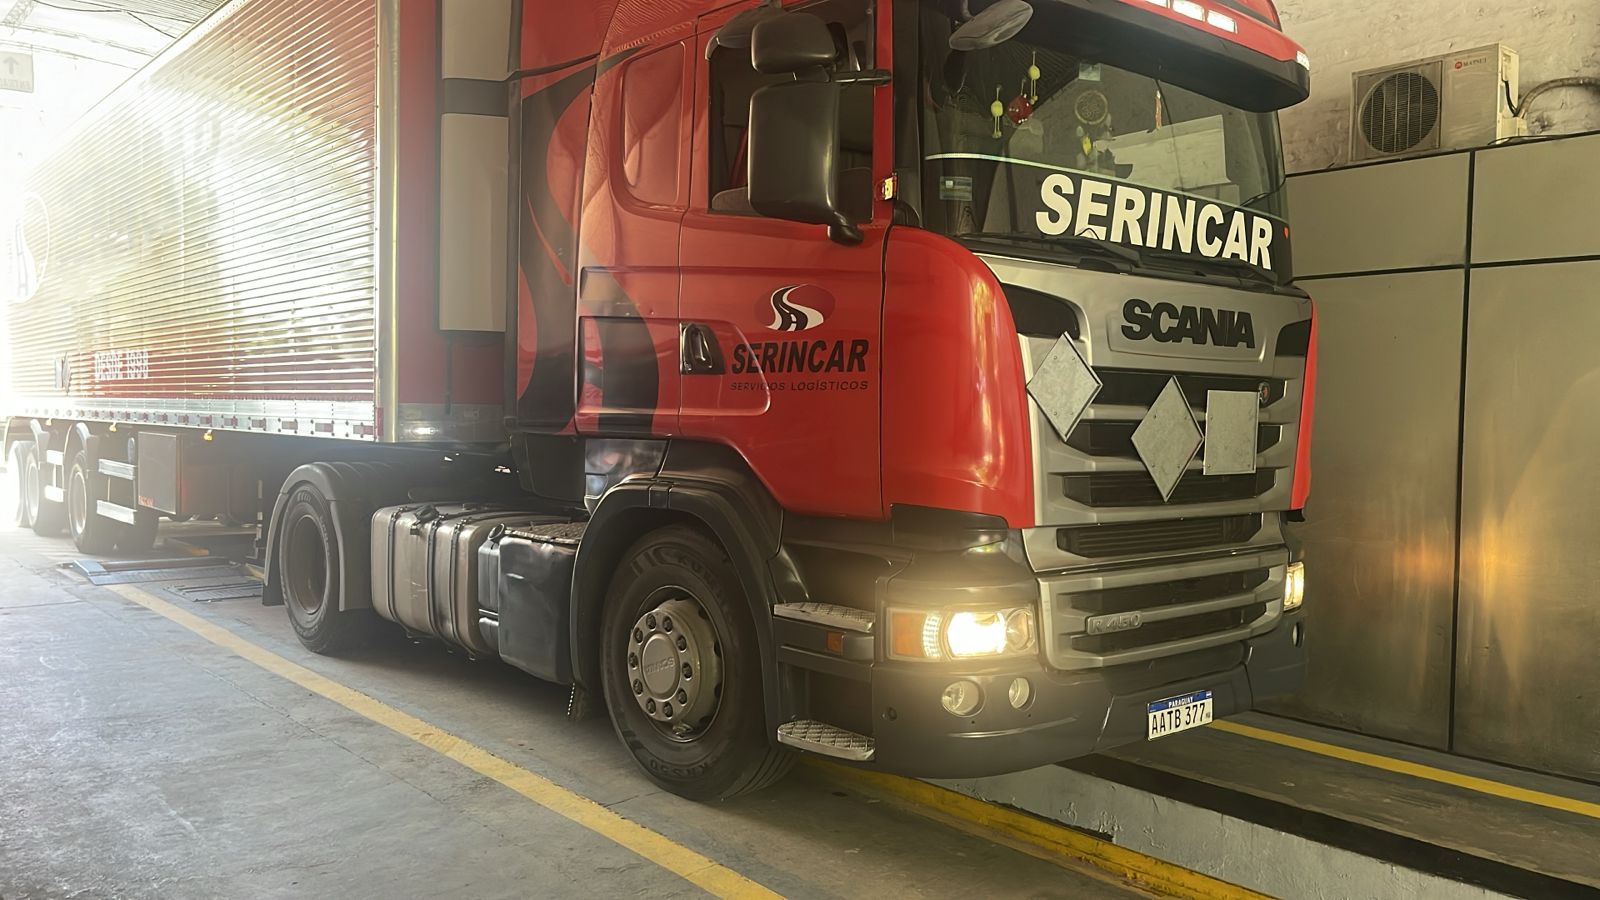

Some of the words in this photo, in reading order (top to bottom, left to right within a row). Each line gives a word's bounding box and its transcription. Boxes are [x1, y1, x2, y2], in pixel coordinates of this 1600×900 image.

[1035, 173, 1273, 271] SERINCAR
[1120, 298, 1256, 349] SCANIA
[731, 339, 869, 374] SERINCAR
[730, 381, 786, 391] SERVICIOS
[791, 379, 869, 391] LOGÍSTICOS
[1151, 708, 1181, 735] AATB
[1185, 702, 1206, 726] 377
[1168, 696, 1194, 709] PARAGUAY
